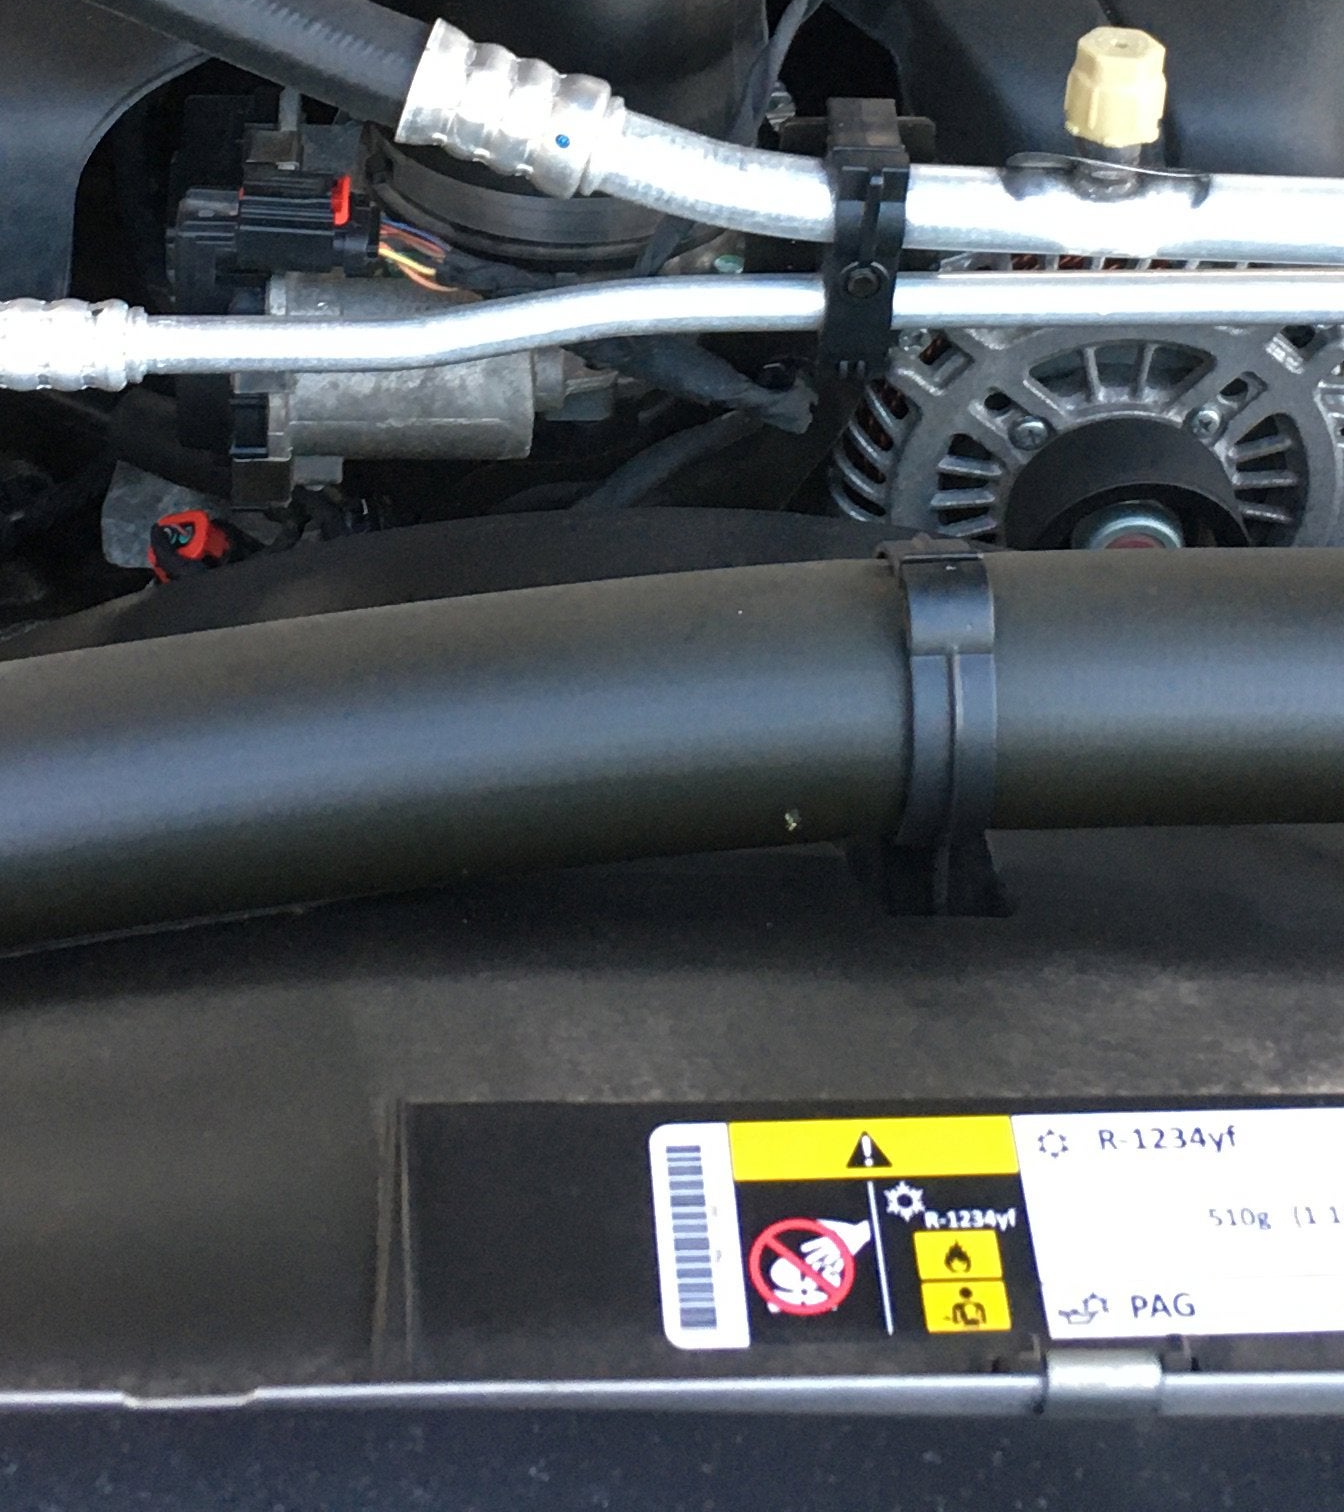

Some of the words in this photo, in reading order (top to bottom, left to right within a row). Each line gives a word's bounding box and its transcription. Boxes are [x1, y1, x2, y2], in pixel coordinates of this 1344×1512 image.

[1098, 1125, 1236, 1153] R-1234yf
[923, 1207, 1017, 1233] R-1234yf
[1208, 1207, 1272, 1230] 510g
[1130, 1292, 1197, 1319] PAG
